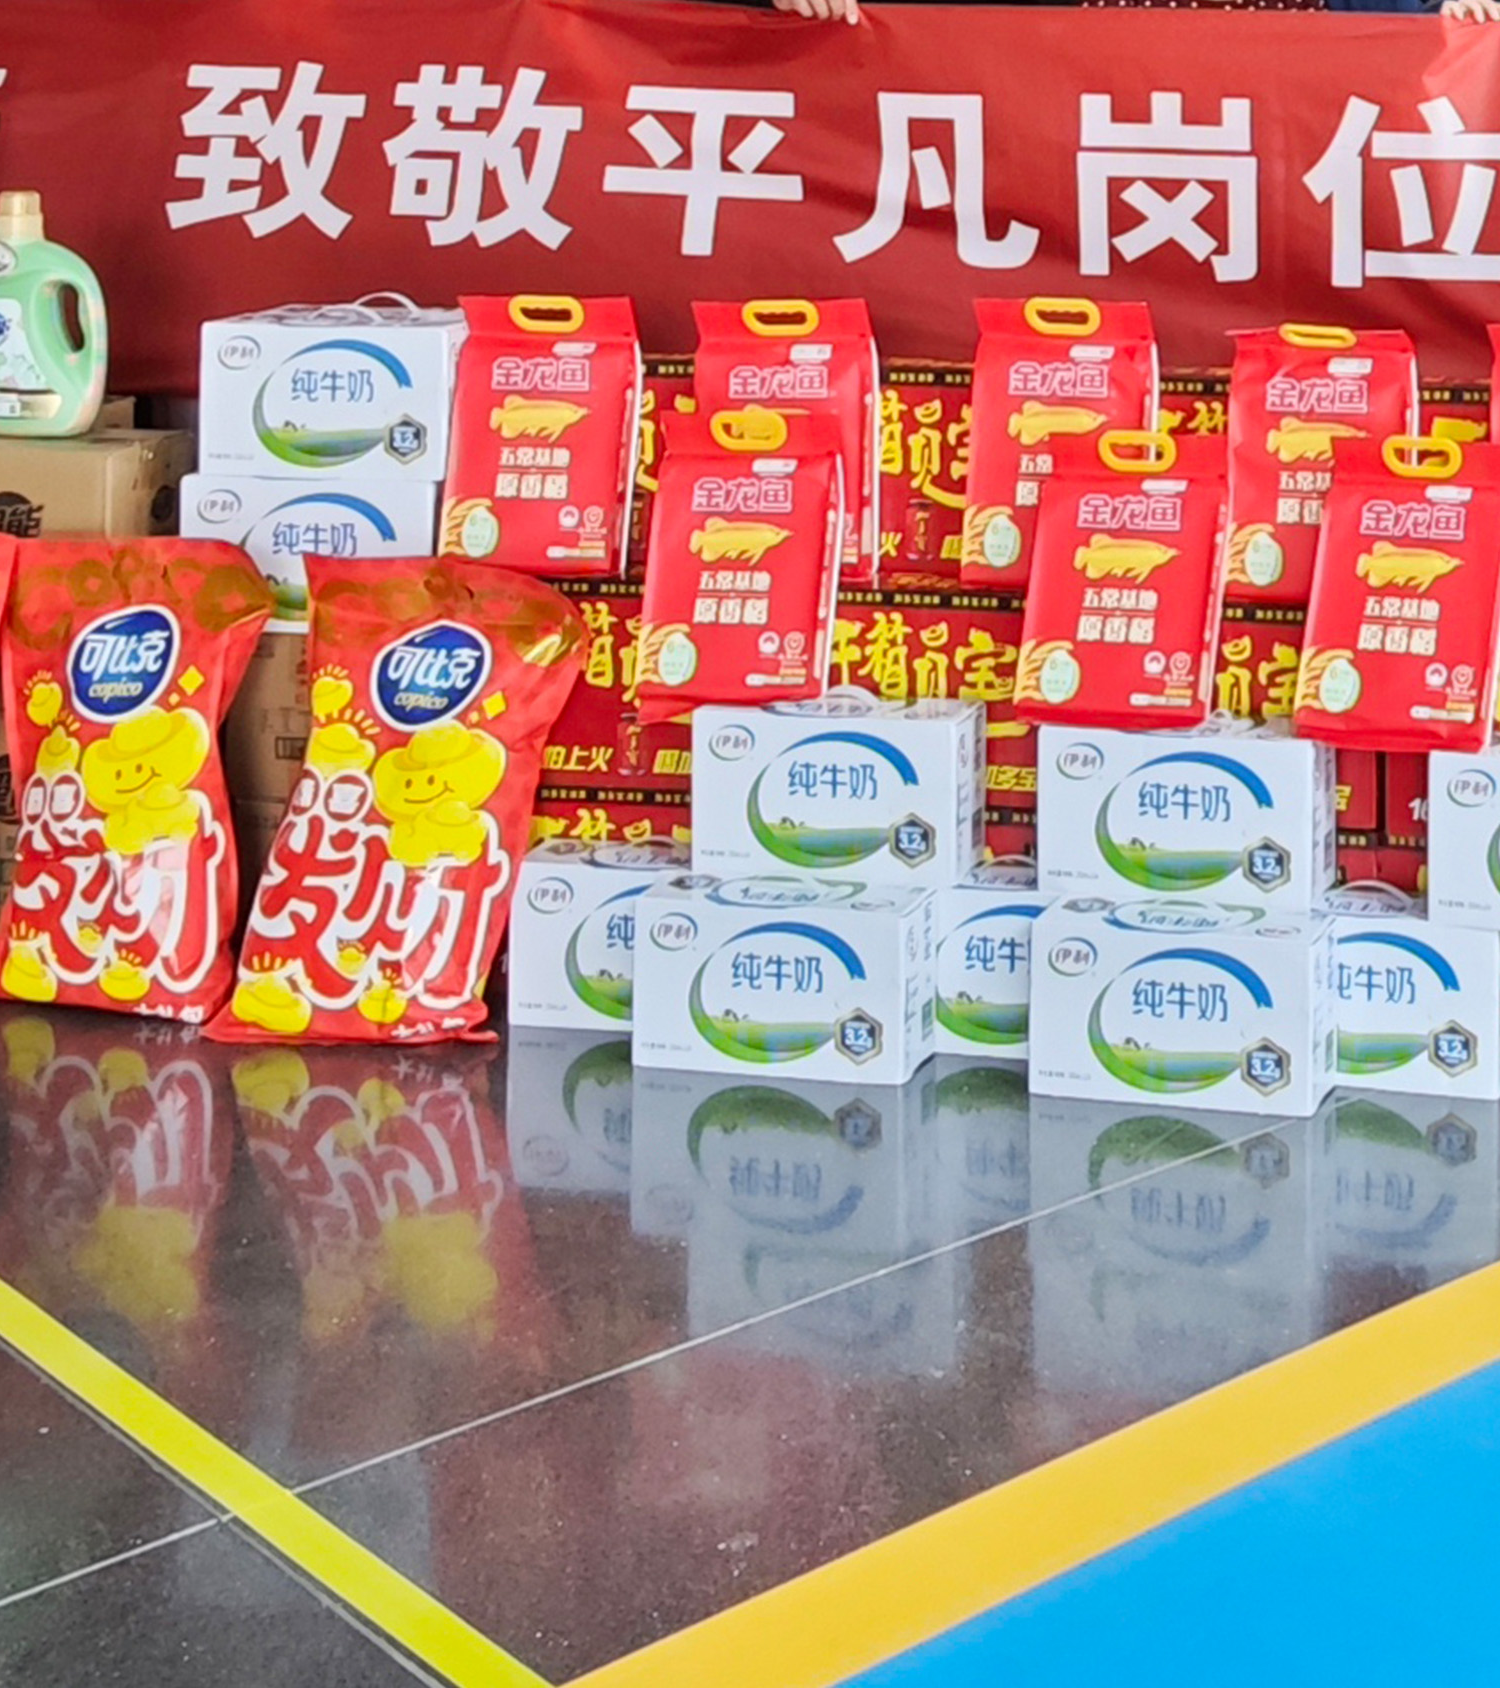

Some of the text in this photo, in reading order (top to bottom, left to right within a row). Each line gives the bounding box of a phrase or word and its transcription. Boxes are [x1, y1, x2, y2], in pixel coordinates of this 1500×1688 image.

[290, 369, 375, 404] 纯牛奶
[490, 355, 591, 393] 金龙鱼
[728, 364, 829, 400] 金龙鱼
[1008, 361, 1109, 398] 金龙鱼
[1265, 377, 1369, 414] 金龙鱼
[498, 446, 571, 468] 五常基地
[1017, 453, 1054, 475] 五常
[691, 477, 793, 514] 金龙鱼
[1278, 471, 1333, 492] 五常基
[1077, 494, 1182, 532] 金龙鱼
[1276, 499, 1324, 526] 原香
[1359, 501, 1465, 540] 金龙鱼
[272, 521, 358, 558] 纯牛奶
[698, 570, 772, 592] 五常基地
[1081, 587, 1159, 610] 五常基地
[1363, 595, 1441, 621] 五常基地
[79, 630, 166, 677] 可比克
[388, 644, 478, 691] 可比克
[87, 679, 143, 699] copico
[392, 692, 448, 712] copico
[715, 734, 750, 751] 伊利
[543, 745, 614, 773] 怕上火
[1062, 752, 1099, 769] 伊利
[788, 760, 878, 802] 纯牛奶
[1454, 776, 1491, 797] 伊利
[1138, 782, 1231, 823] 纯牛奶
[533, 887, 567, 904] 伊利
[656, 923, 693, 940] 伊利
[964, 934, 1029, 975] 纯牛
[1054, 948, 1091, 965] 伊利
[730, 952, 824, 994] 纯牛奶
[1131, 978, 1229, 1023] 纯牛奶
